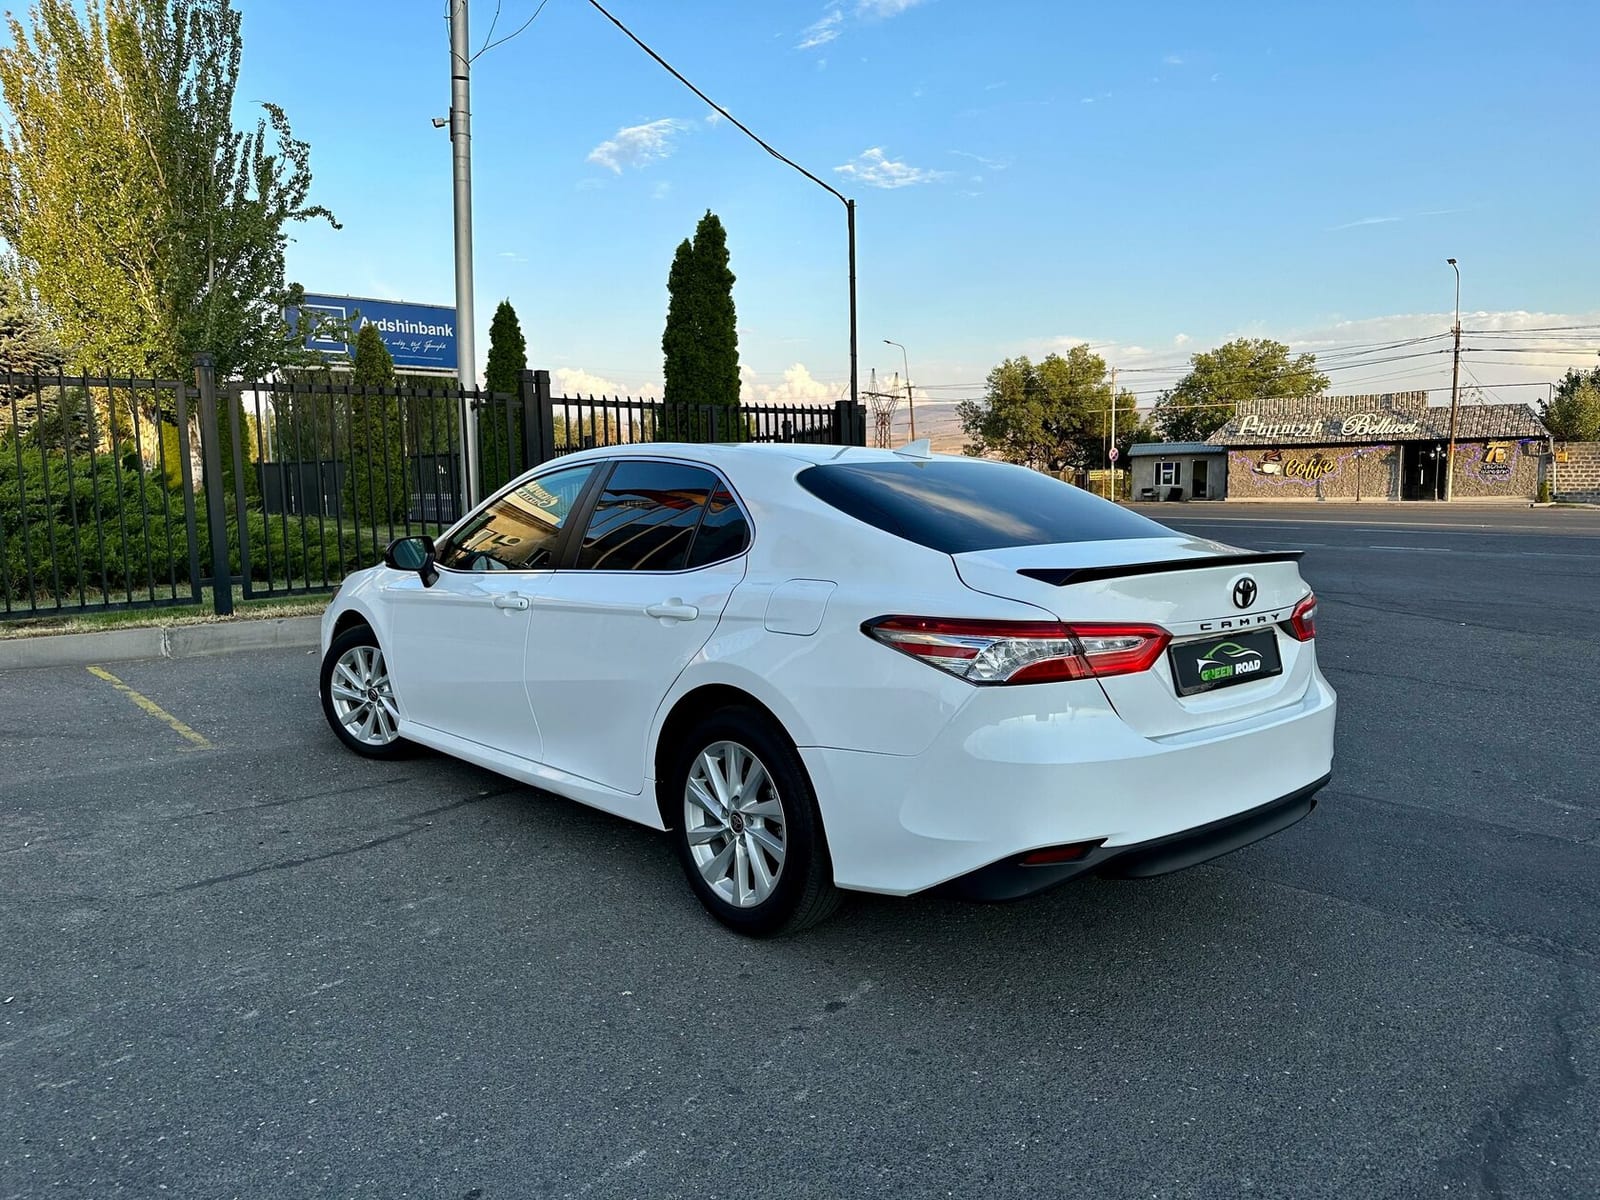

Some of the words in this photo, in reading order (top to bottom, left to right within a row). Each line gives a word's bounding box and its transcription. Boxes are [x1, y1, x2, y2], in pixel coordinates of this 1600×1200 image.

[359, 316, 454, 337] Ardshinbank
[1341, 413, 1418, 436] Bellucci
[1286, 458, 1336, 480] Coffe
[1200, 613, 1281, 631] CAMRY
[1200, 665, 1233, 682] GREEN
[1235, 659, 1261, 675] ROAD
